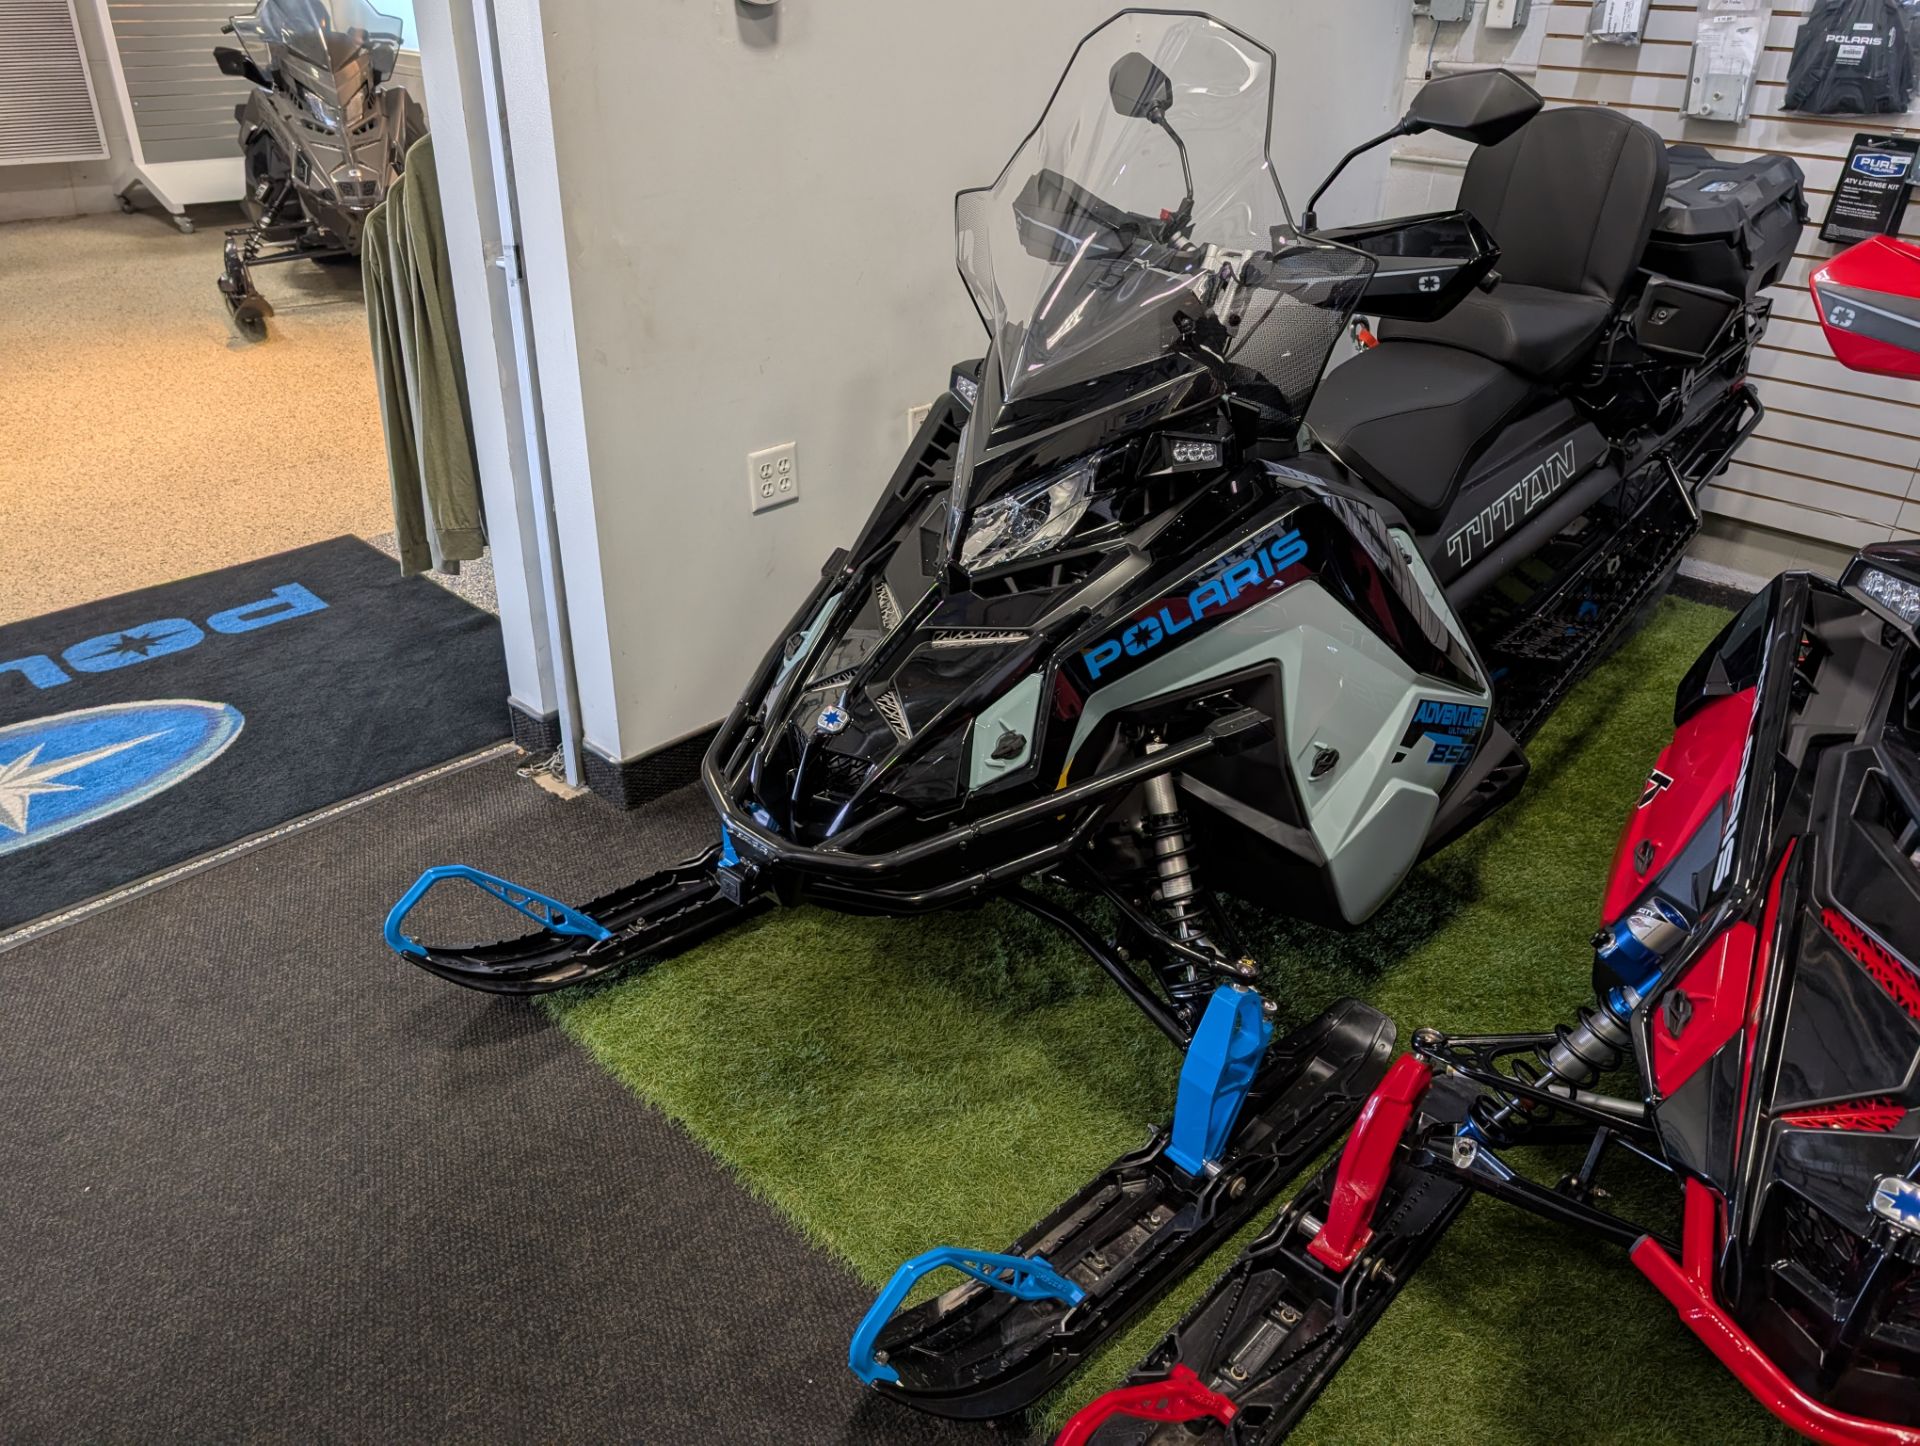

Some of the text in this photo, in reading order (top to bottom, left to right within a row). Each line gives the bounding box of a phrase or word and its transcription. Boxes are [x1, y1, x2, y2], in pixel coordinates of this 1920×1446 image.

[1826, 34, 1883, 46] POLARIS
[1844, 177, 1858, 185] ATV
[1858, 179, 1887, 189] LICENSE
[1446, 439, 1576, 567] TITAN
[1083, 528, 1309, 680] POLARIS
[1413, 701, 1487, 727] ADVENTURE
[1427, 743, 1474, 765] 850
